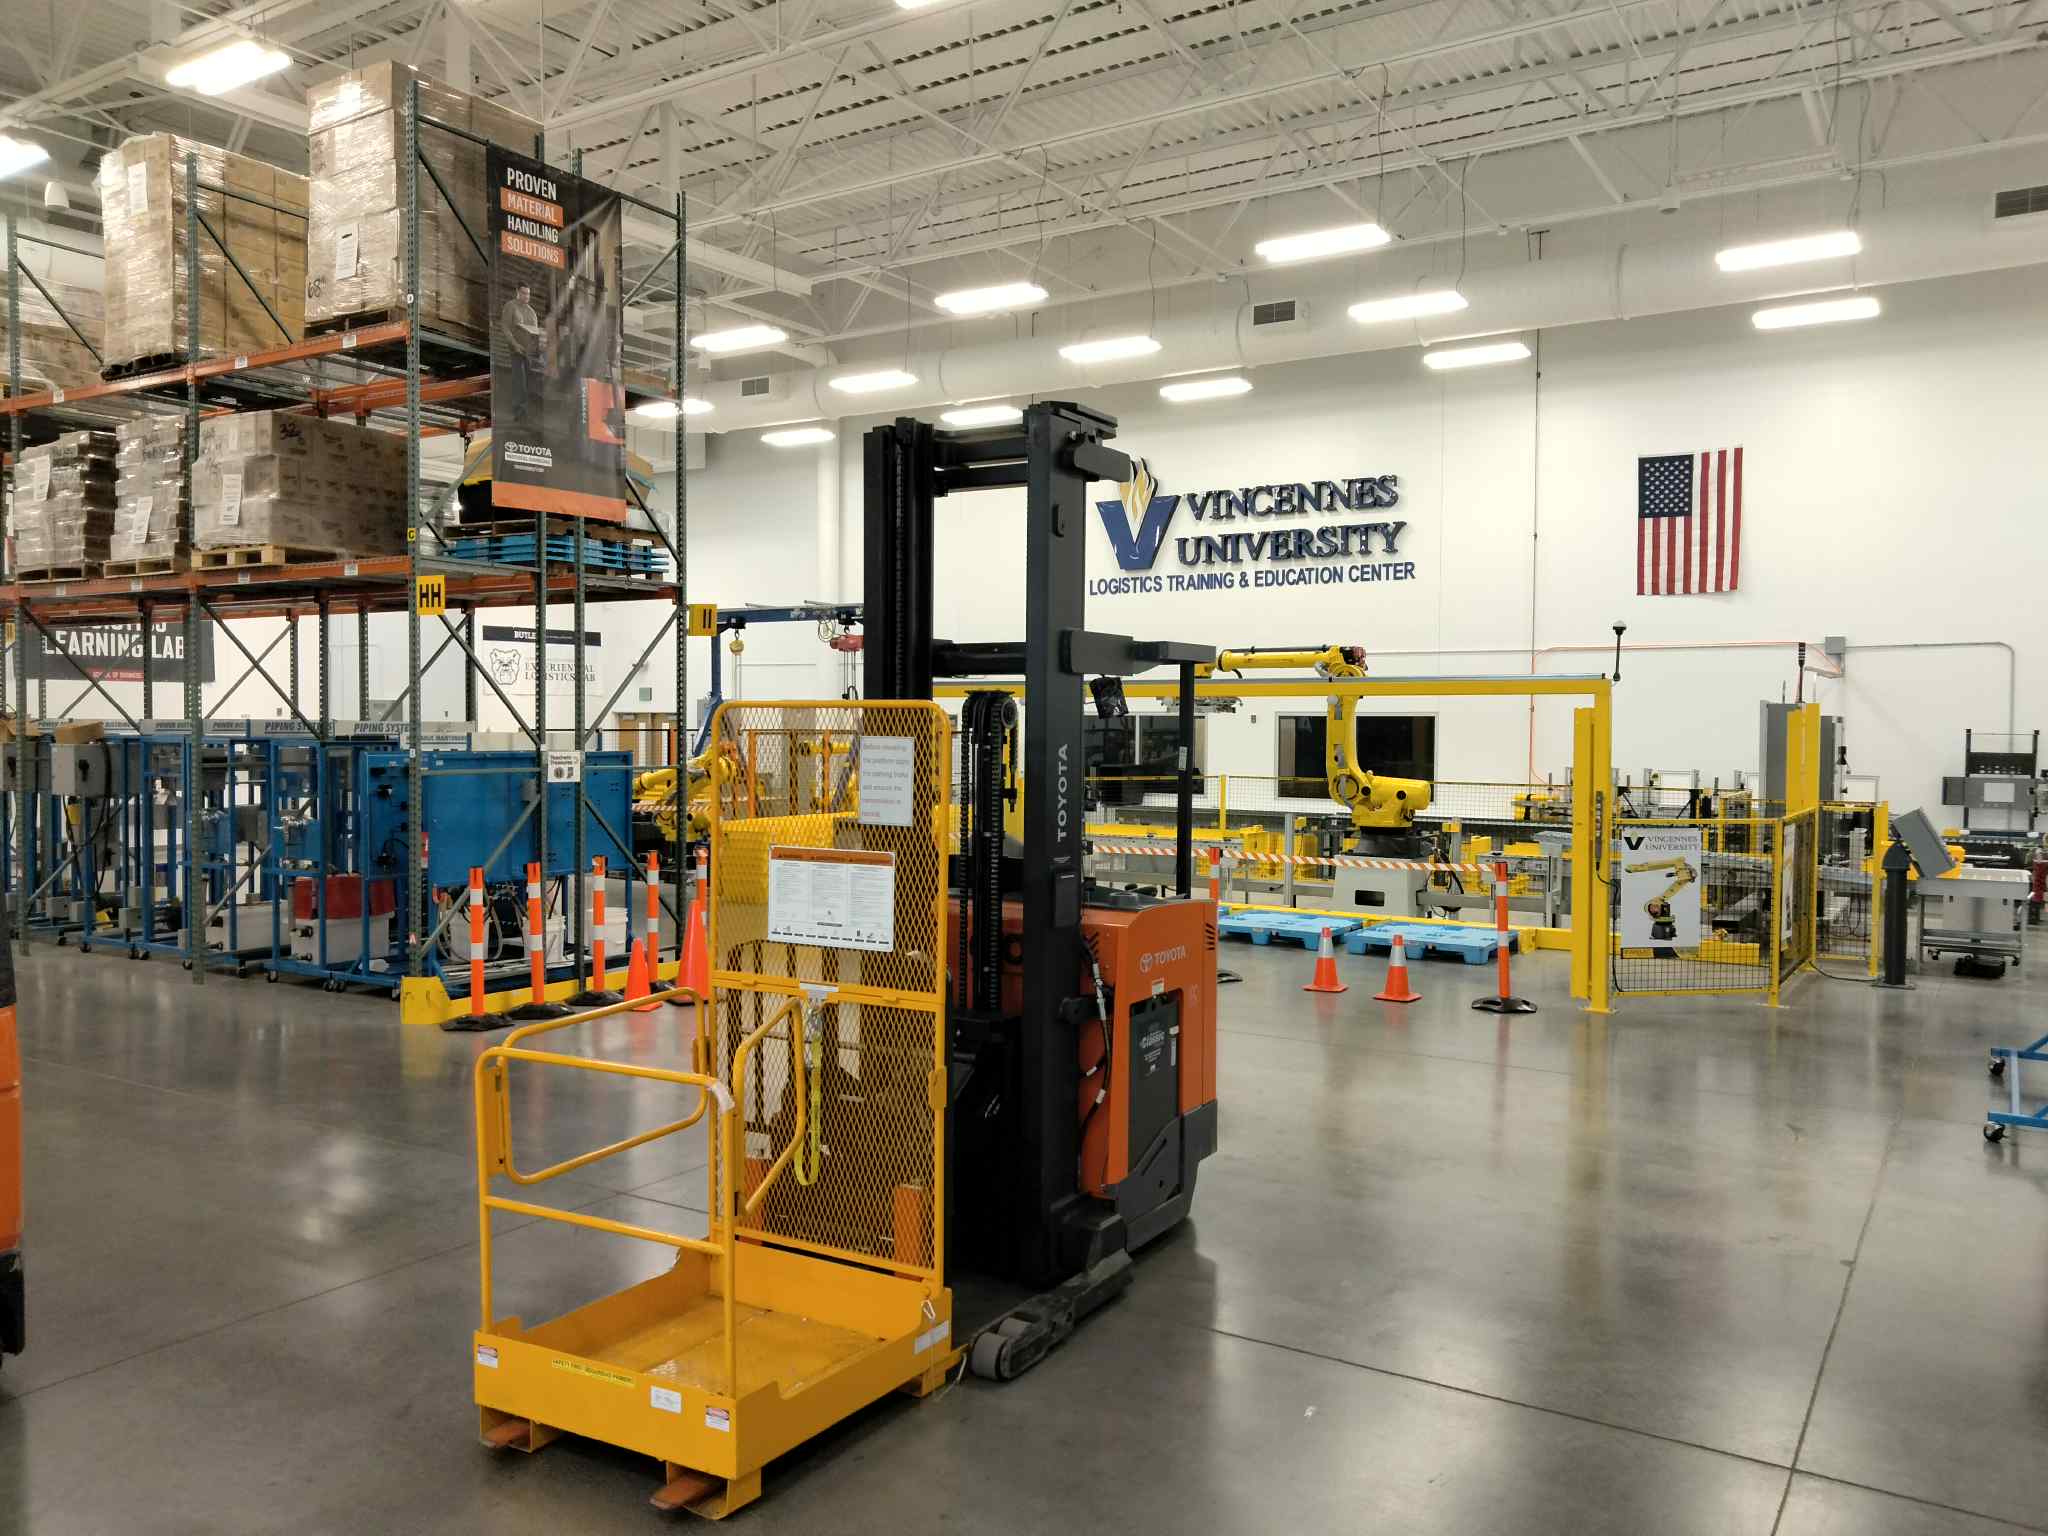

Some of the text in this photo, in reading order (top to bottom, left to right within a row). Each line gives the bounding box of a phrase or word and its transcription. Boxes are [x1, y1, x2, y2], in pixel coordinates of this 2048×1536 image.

[507, 167, 557, 200] PROVEN
[507, 192, 558, 222] MATERIAL
[507, 215, 559, 243] HANDLING
[507, 236, 559, 263] SOLUTIONS
[518, 444, 552, 457] TOYOTA
[1183, 475, 1399, 520] VINCENNES
[1174, 521, 1407, 565] UNIVERSITY
[1089, 561, 1416, 595] LOGISTICS TRAINING & EDUCATION CENTER
[420, 584, 441, 607] HH
[42, 630, 144, 658] LEARNING
[514, 630, 537, 639] BUTLE
[264, 721, 296, 731] PIPING
[354, 723, 384, 733] PIPING
[1057, 744, 1068, 842] TOYOTA
[1153, 945, 1186, 966] TOYOTA
